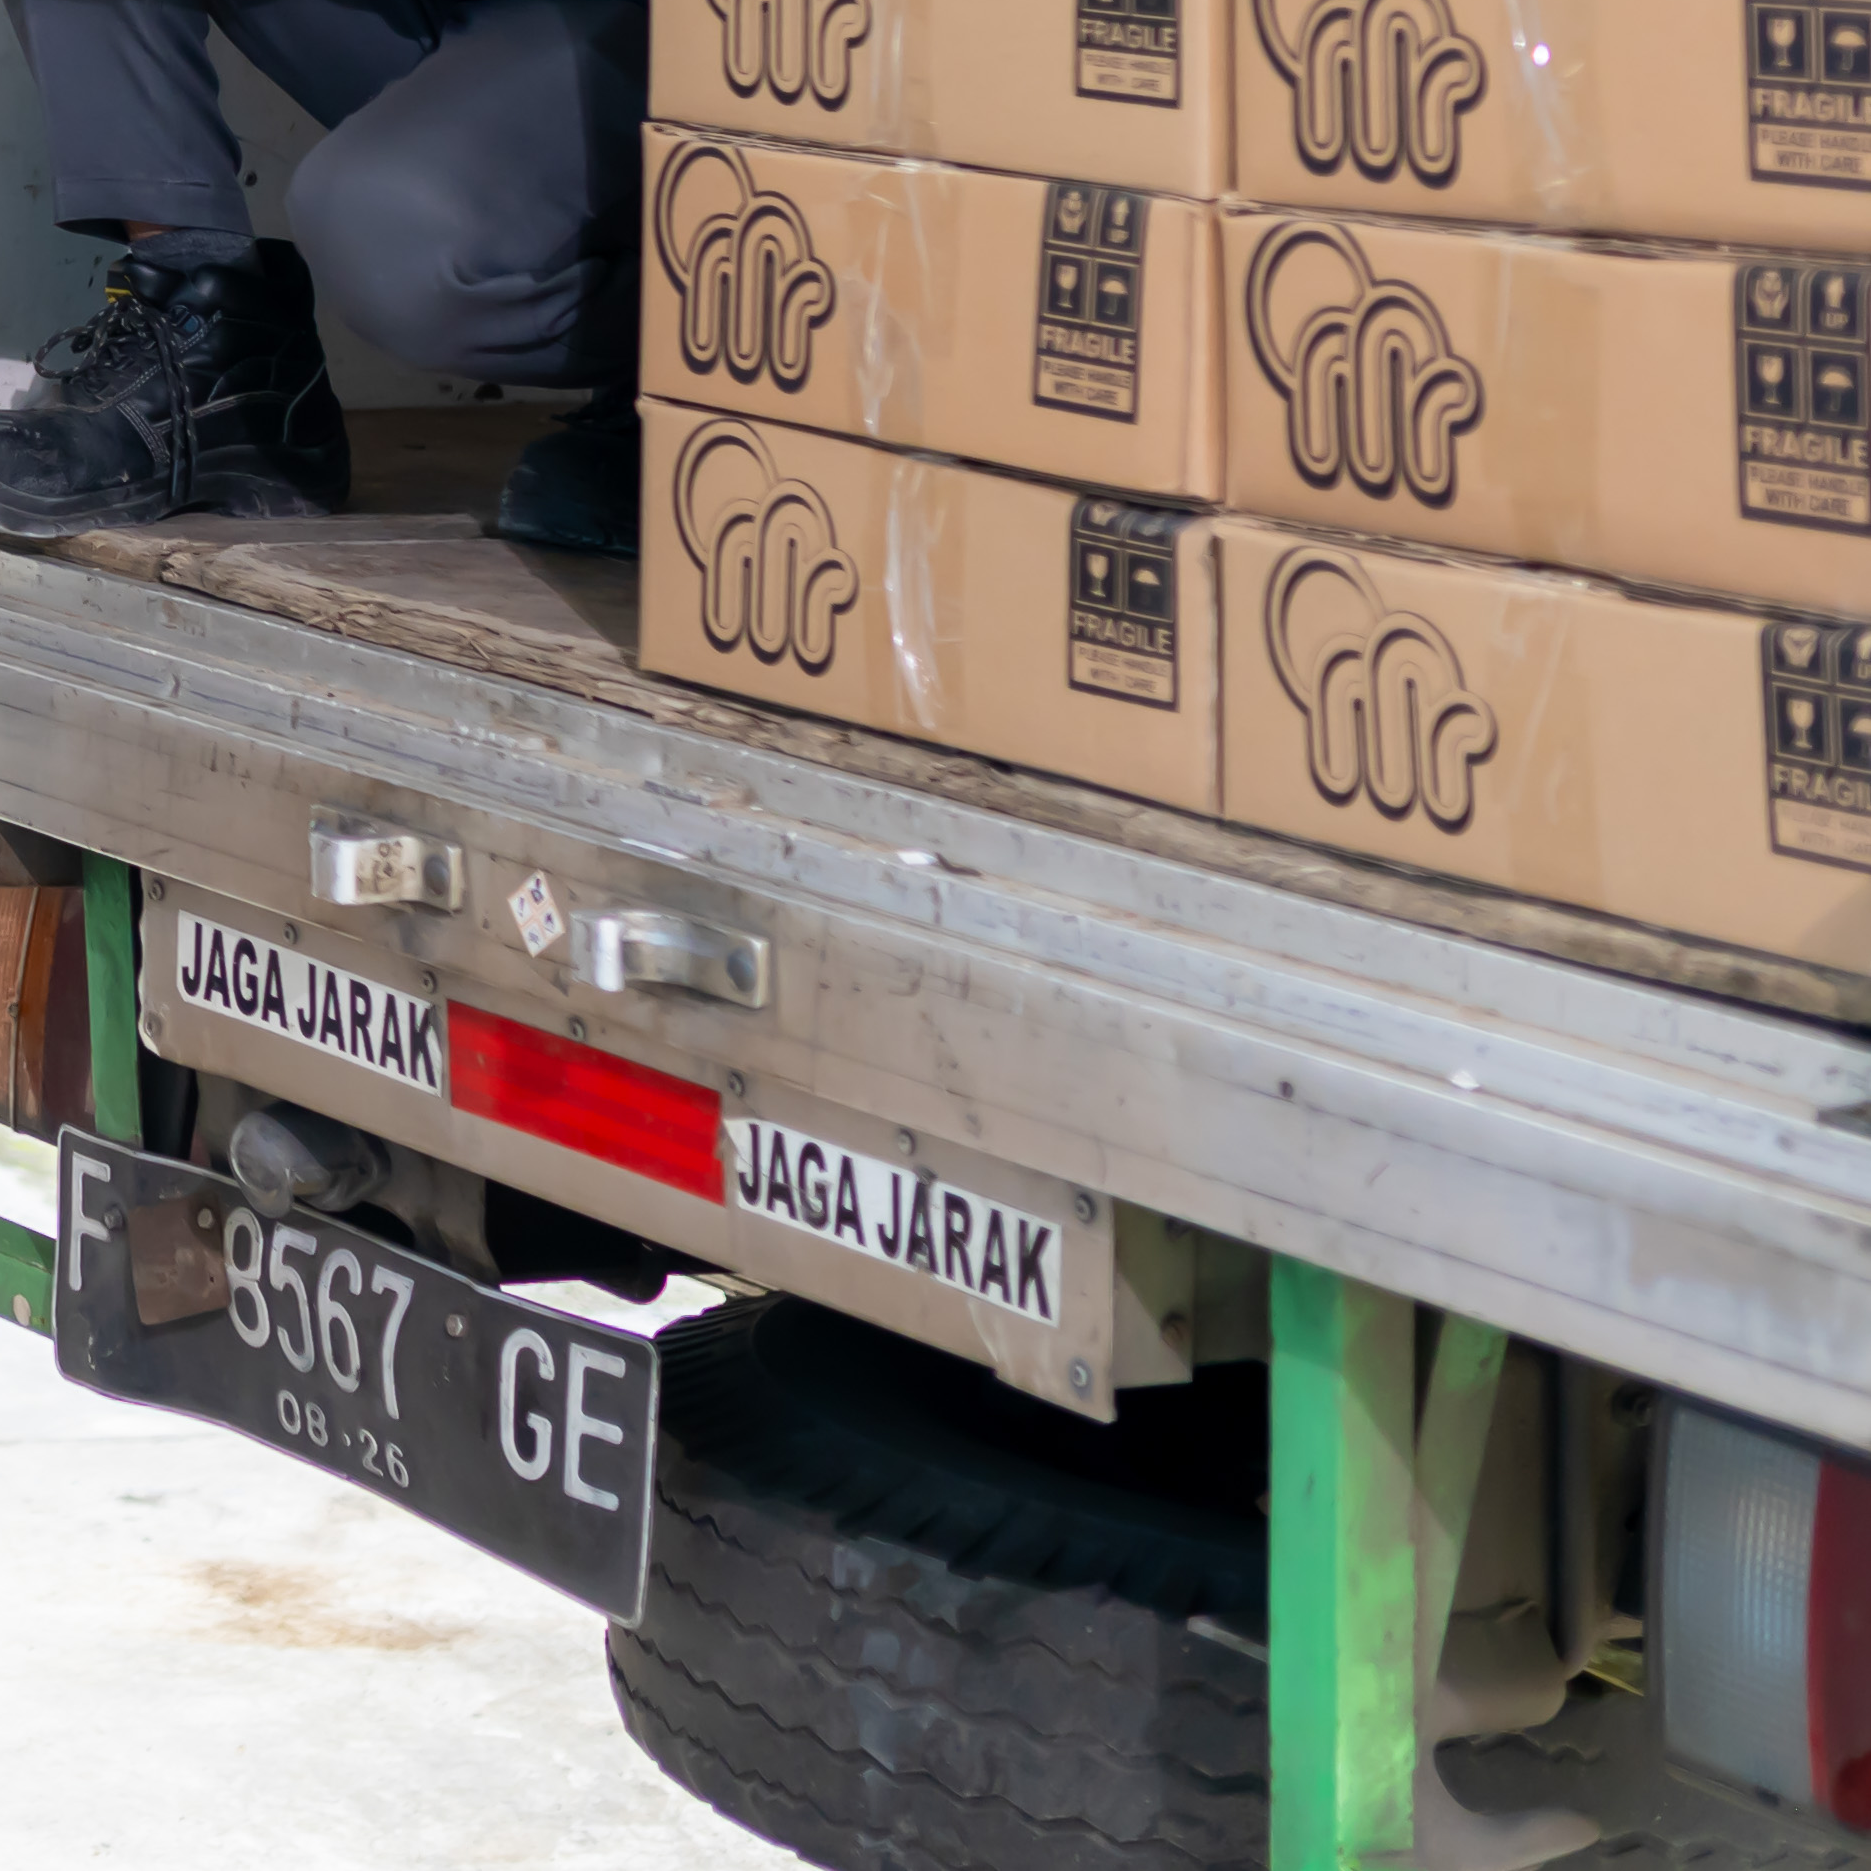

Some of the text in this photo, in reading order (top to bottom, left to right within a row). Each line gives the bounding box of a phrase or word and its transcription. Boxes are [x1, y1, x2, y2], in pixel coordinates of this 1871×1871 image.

[1081, 19, 1176, 52] FRAGILE
[1041, 325, 1135, 364] FRAGILE
[1745, 425, 1868, 468] FRAGILE
[1074, 614, 1172, 654] FRAGILE
[181, 921, 442, 1094] JAGA JARAK
[739, 1128, 1053, 1320] JAGA JARAK
[66, 1150, 627, 1511] F 8567 GE
